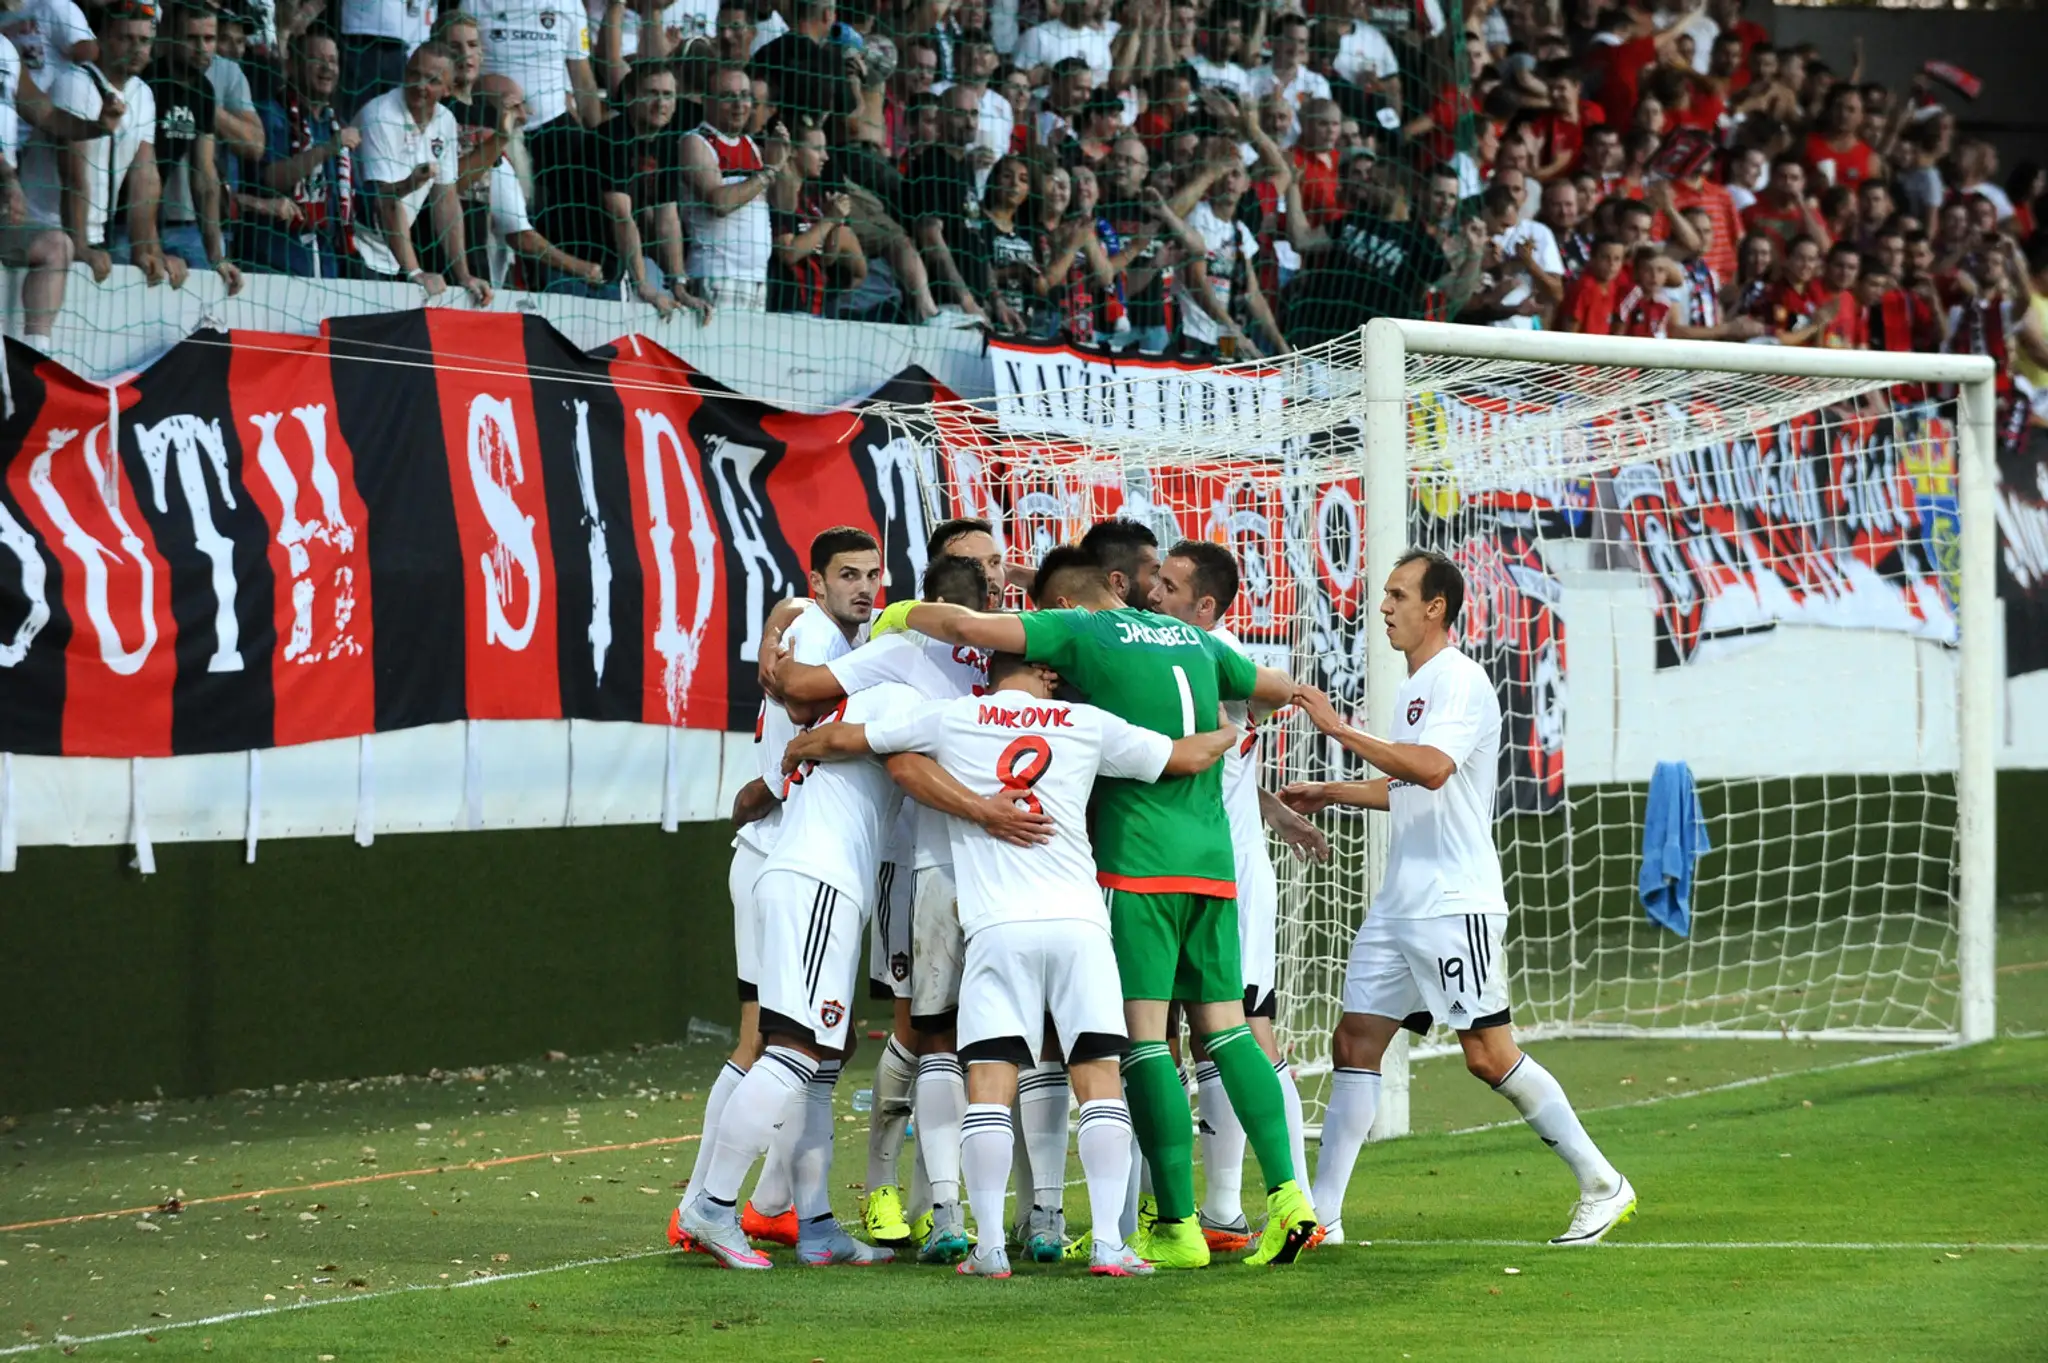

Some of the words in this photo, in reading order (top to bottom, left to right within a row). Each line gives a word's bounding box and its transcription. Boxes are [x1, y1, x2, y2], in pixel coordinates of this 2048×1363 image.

[466, 392, 795, 722] SIDE
[1171, 665, 1196, 738] 1
[996, 735, 1052, 815] 8
[1438, 957, 1465, 994] 19
